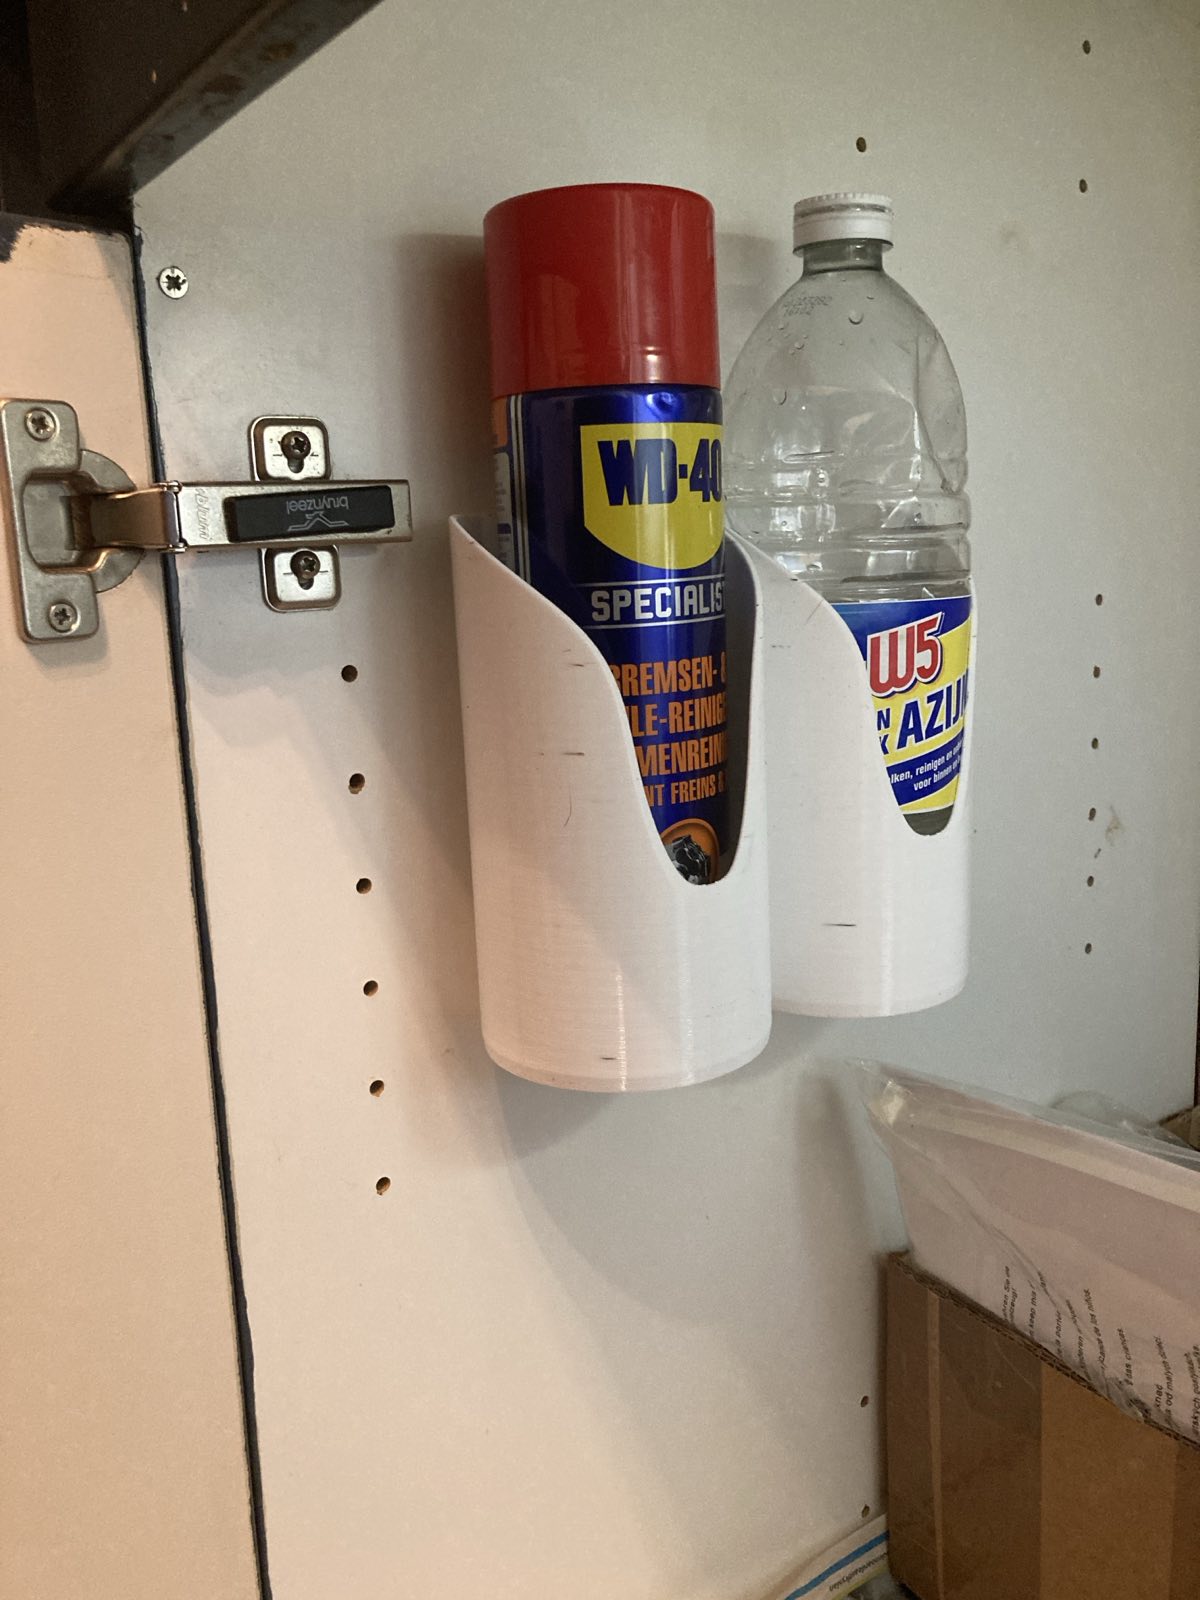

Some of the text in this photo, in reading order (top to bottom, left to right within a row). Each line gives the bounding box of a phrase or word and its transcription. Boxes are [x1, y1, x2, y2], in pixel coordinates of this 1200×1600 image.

[598, 438, 723, 506] WD-40
[286, 495, 349, 515] bruynzeel
[591, 582, 725, 621] SPECIALIS
[868, 612, 943, 696] W5
[913, 777, 932, 791] voor
[933, 765, 952, 783] binnen
[915, 756, 945, 776] reinigen
[671, 774, 716, 804] FREINS
